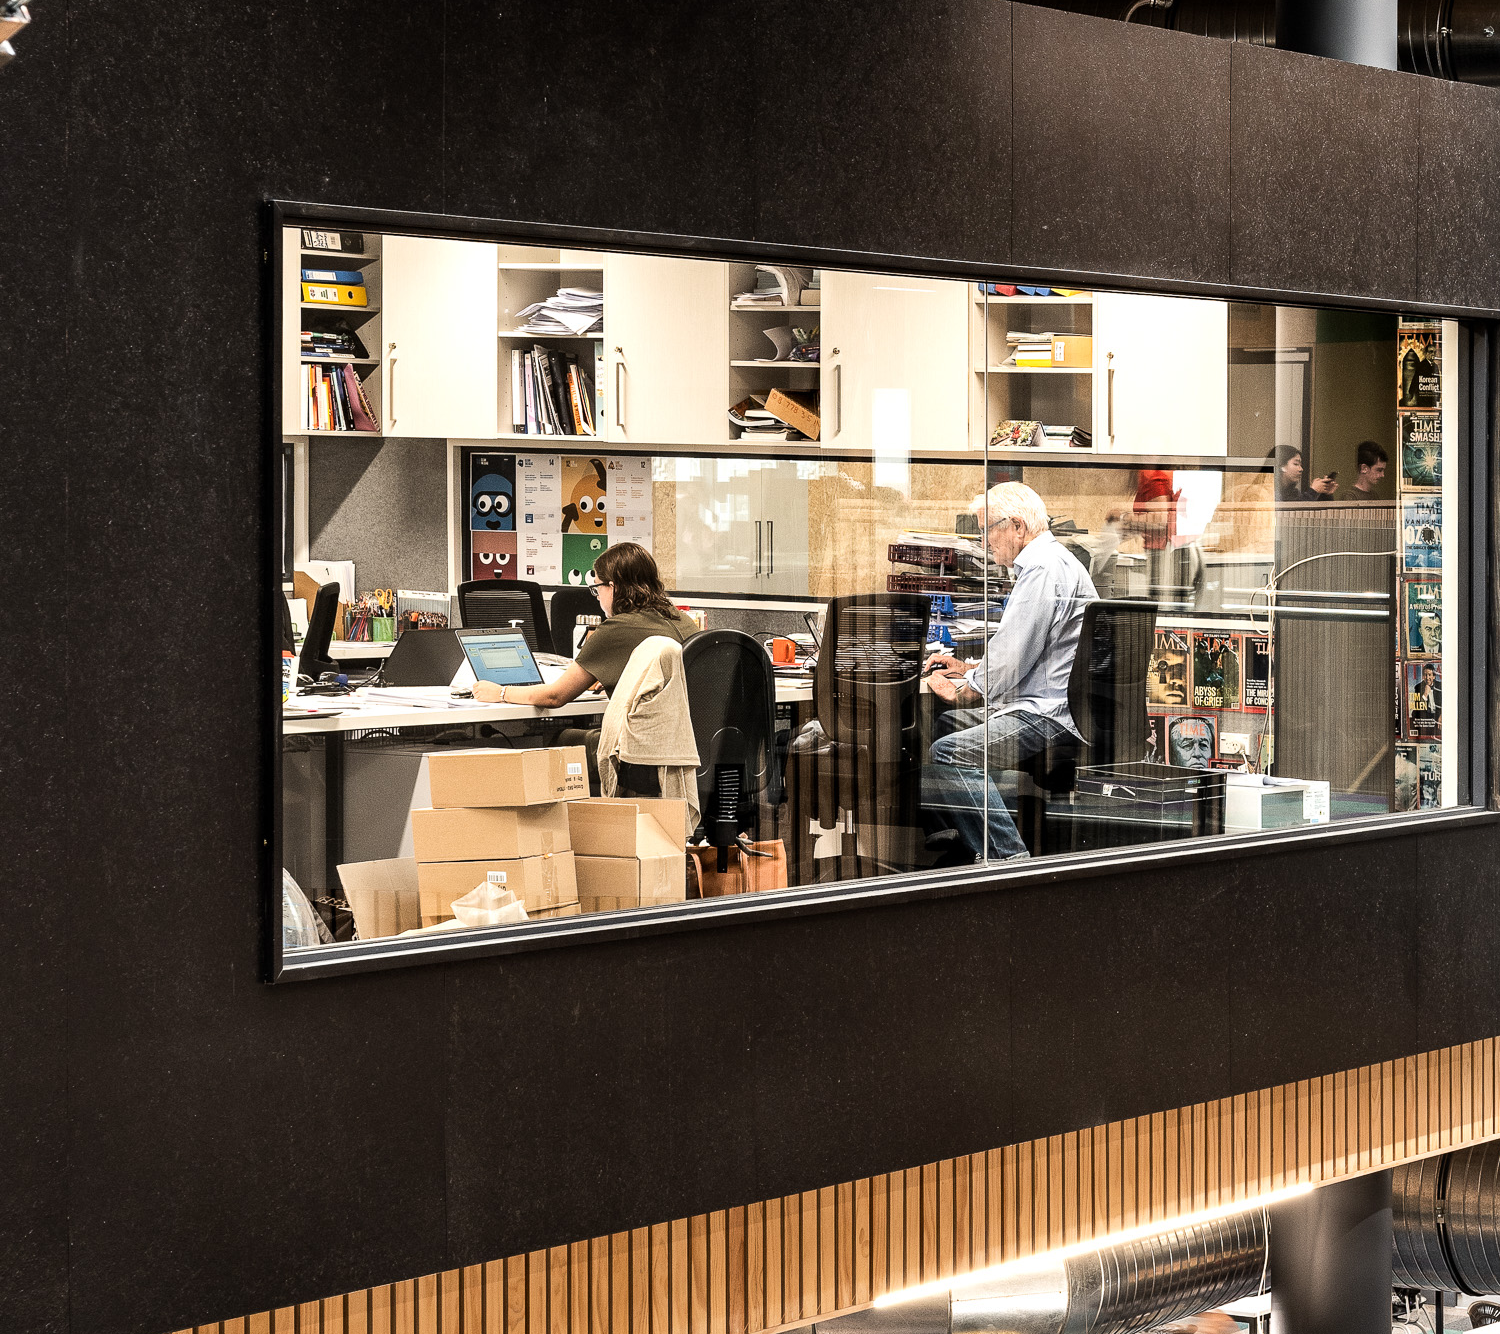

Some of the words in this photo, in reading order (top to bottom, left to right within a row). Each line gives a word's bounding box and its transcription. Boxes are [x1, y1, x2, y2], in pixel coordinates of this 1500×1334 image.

[1419, 375, 1438, 383] Korean
[1419, 383, 1440, 391] Conflict
[1412, 420, 1441, 432] TIME
[1194, 686, 1217, 696] ABYSS
[1246, 689, 1256, 697] THE
[1194, 696, 1204, 706] OF
[1205, 696, 1224, 706] GRIEF
[1246, 697, 1253, 705] OF
[1180, 723, 1207, 737] TIME
